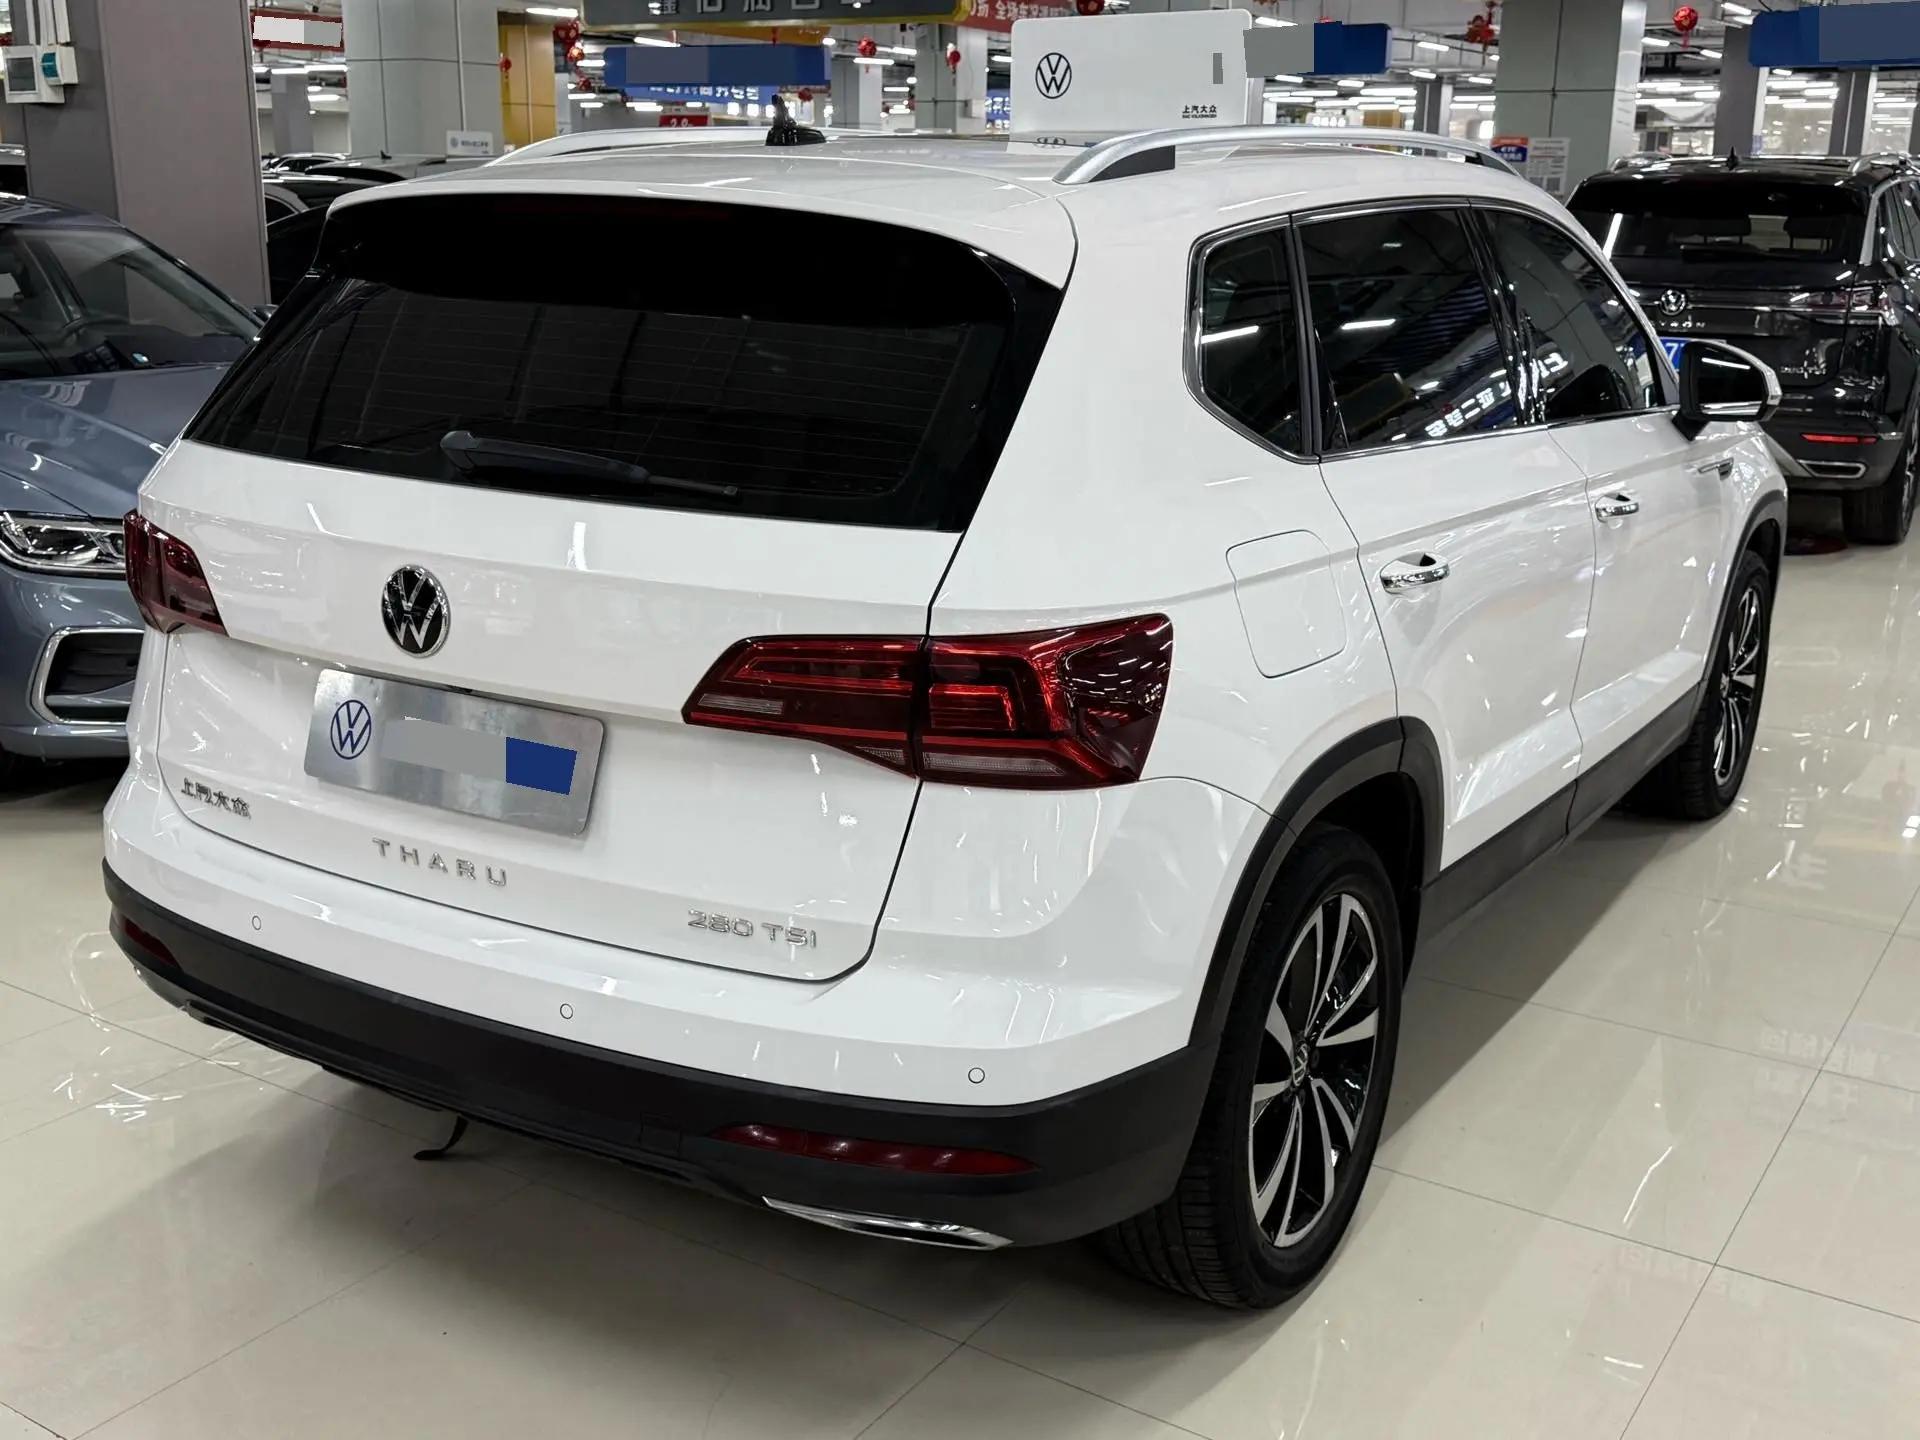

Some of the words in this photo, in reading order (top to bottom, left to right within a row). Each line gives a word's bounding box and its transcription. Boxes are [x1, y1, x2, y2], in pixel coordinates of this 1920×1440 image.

[1182, 104, 1217, 114] 上汽大众
[373, 837, 508, 889] THARU
[688, 908, 754, 937] 280
[761, 922, 817, 948] TSI
